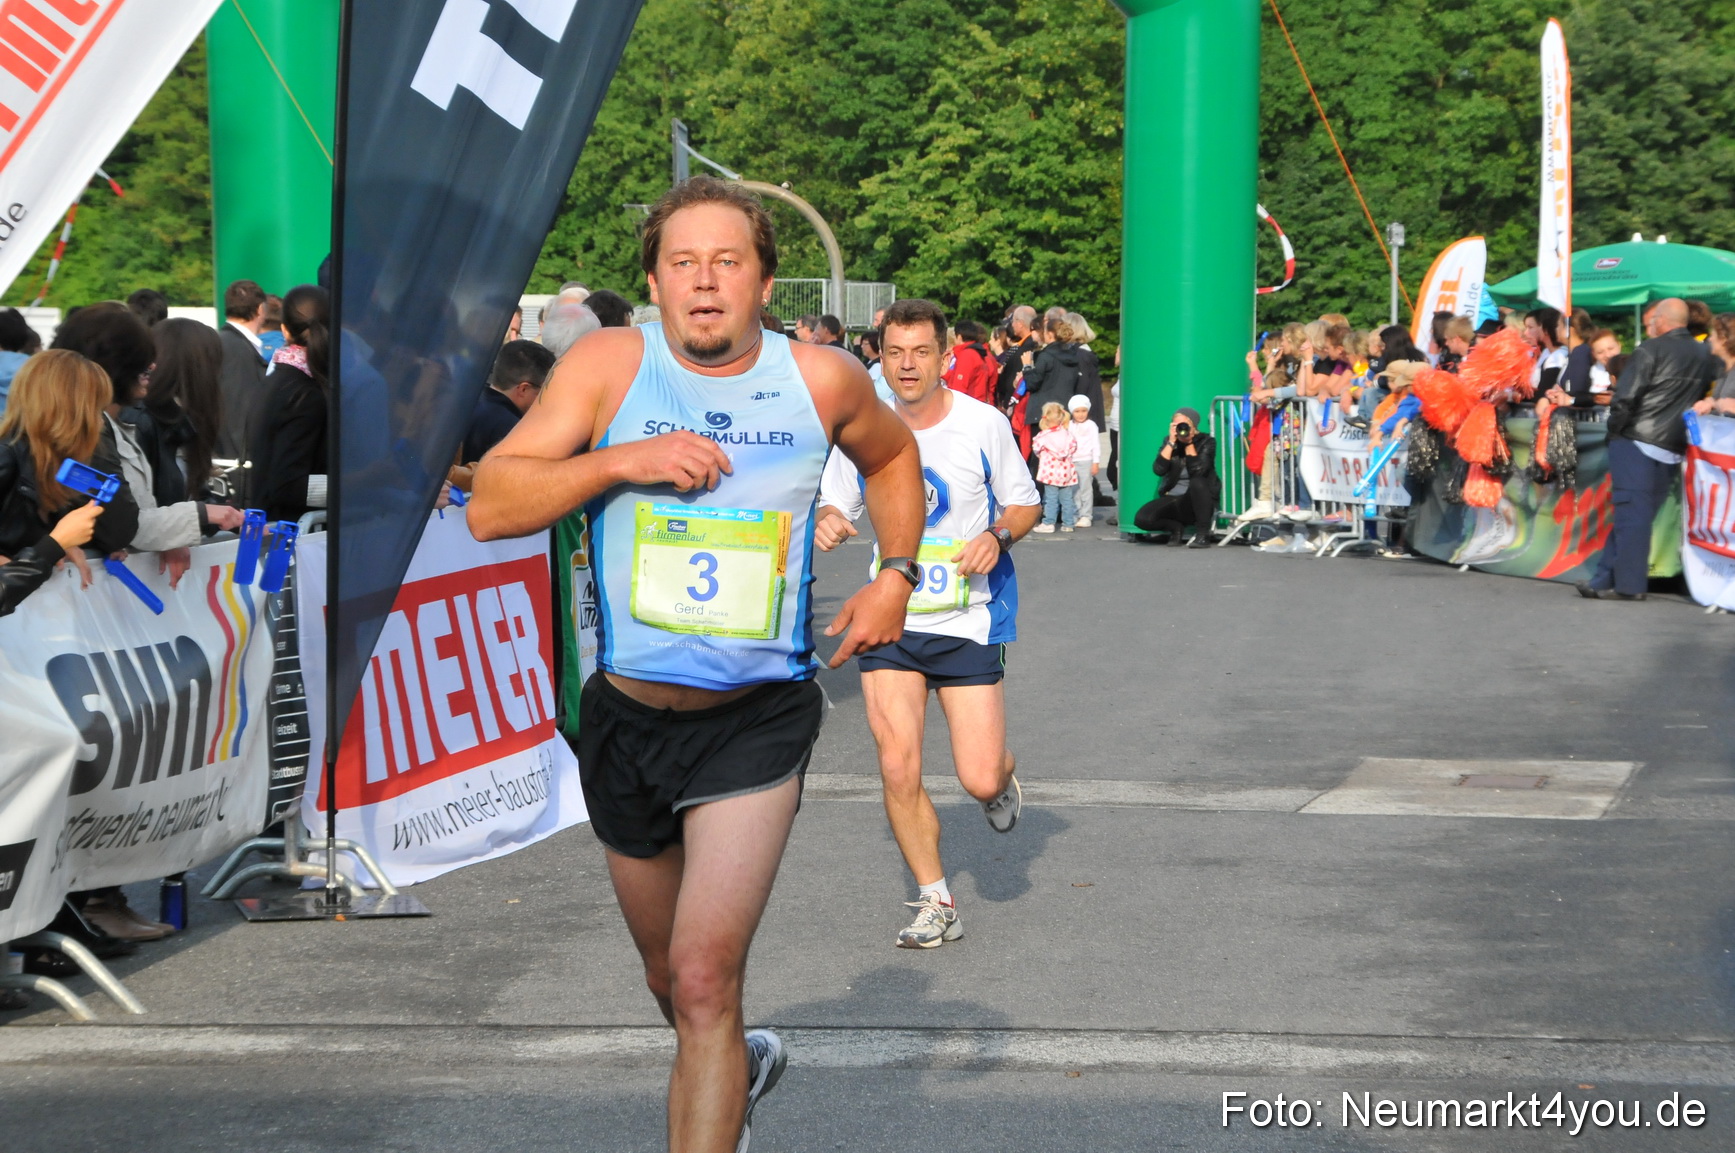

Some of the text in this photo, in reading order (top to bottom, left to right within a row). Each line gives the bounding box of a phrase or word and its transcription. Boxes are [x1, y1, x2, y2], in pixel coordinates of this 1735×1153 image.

[657, 529, 707, 543] firmenlauf
[686, 551, 719, 602] 3
[674, 602, 705, 616] Gerd
[358, 581, 554, 784] MEIER
